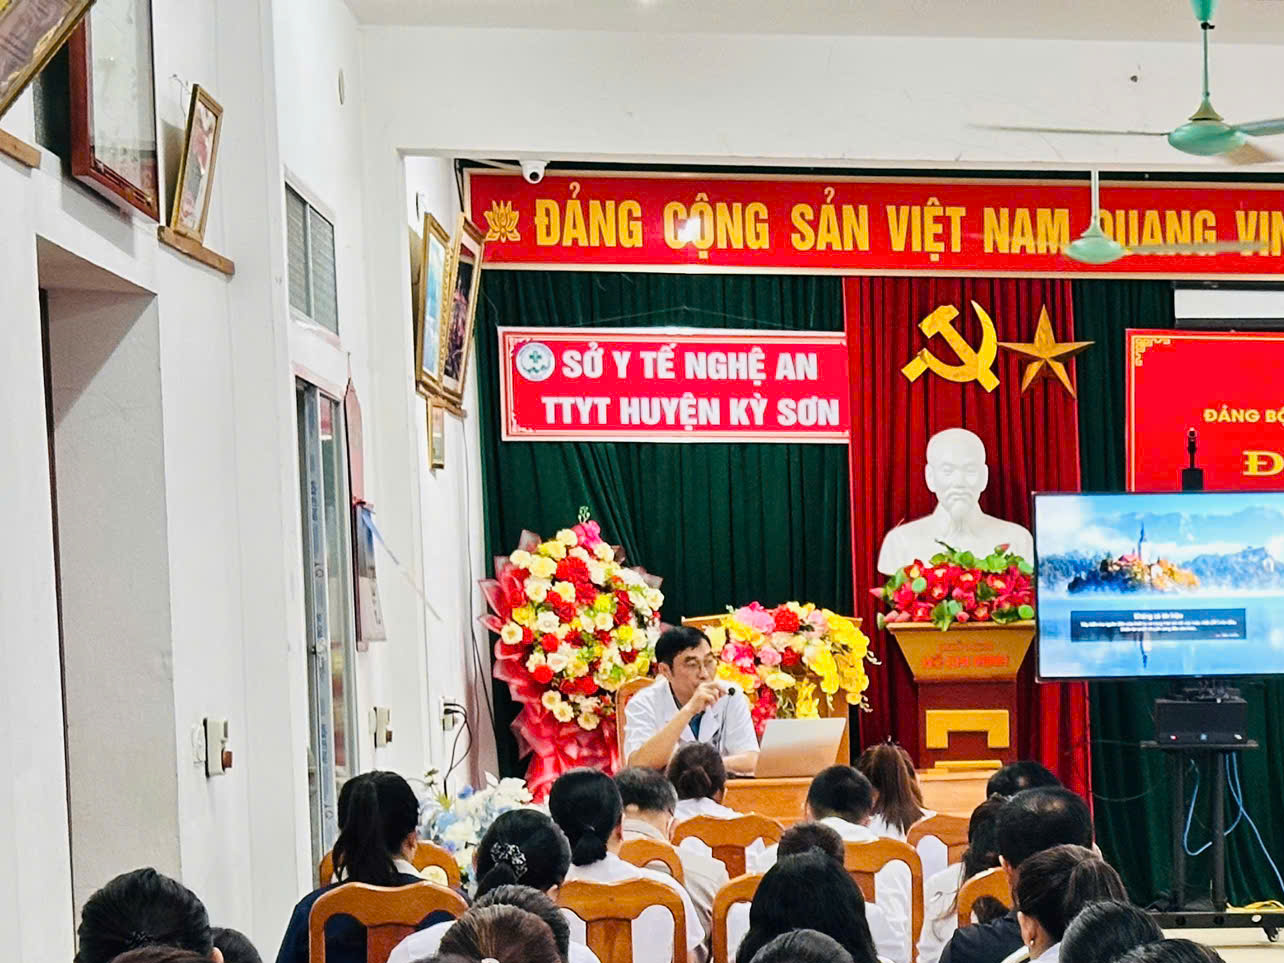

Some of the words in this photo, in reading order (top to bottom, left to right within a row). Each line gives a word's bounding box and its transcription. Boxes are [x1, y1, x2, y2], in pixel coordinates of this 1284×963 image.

[534, 182, 643, 248] ĐẢNG
[664, 192, 770, 259] CỘNG
[791, 187, 870, 253] SẢN
[886, 196, 966, 261] VIỆT
[983, 206, 1069, 256] NAM
[562, 341, 603, 379] SỞ
[612, 349, 631, 379] Y
[640, 342, 677, 381] TẾ
[685, 346, 766, 388] NGHỆ
[775, 352, 818, 381] AN
[541, 397, 611, 424] TTYT
[619, 392, 721, 431] HUYỆN
[729, 394, 766, 425] KỲ
[776, 397, 840, 425] SƠN
[1203, 405, 1260, 424] ĐẢNG
